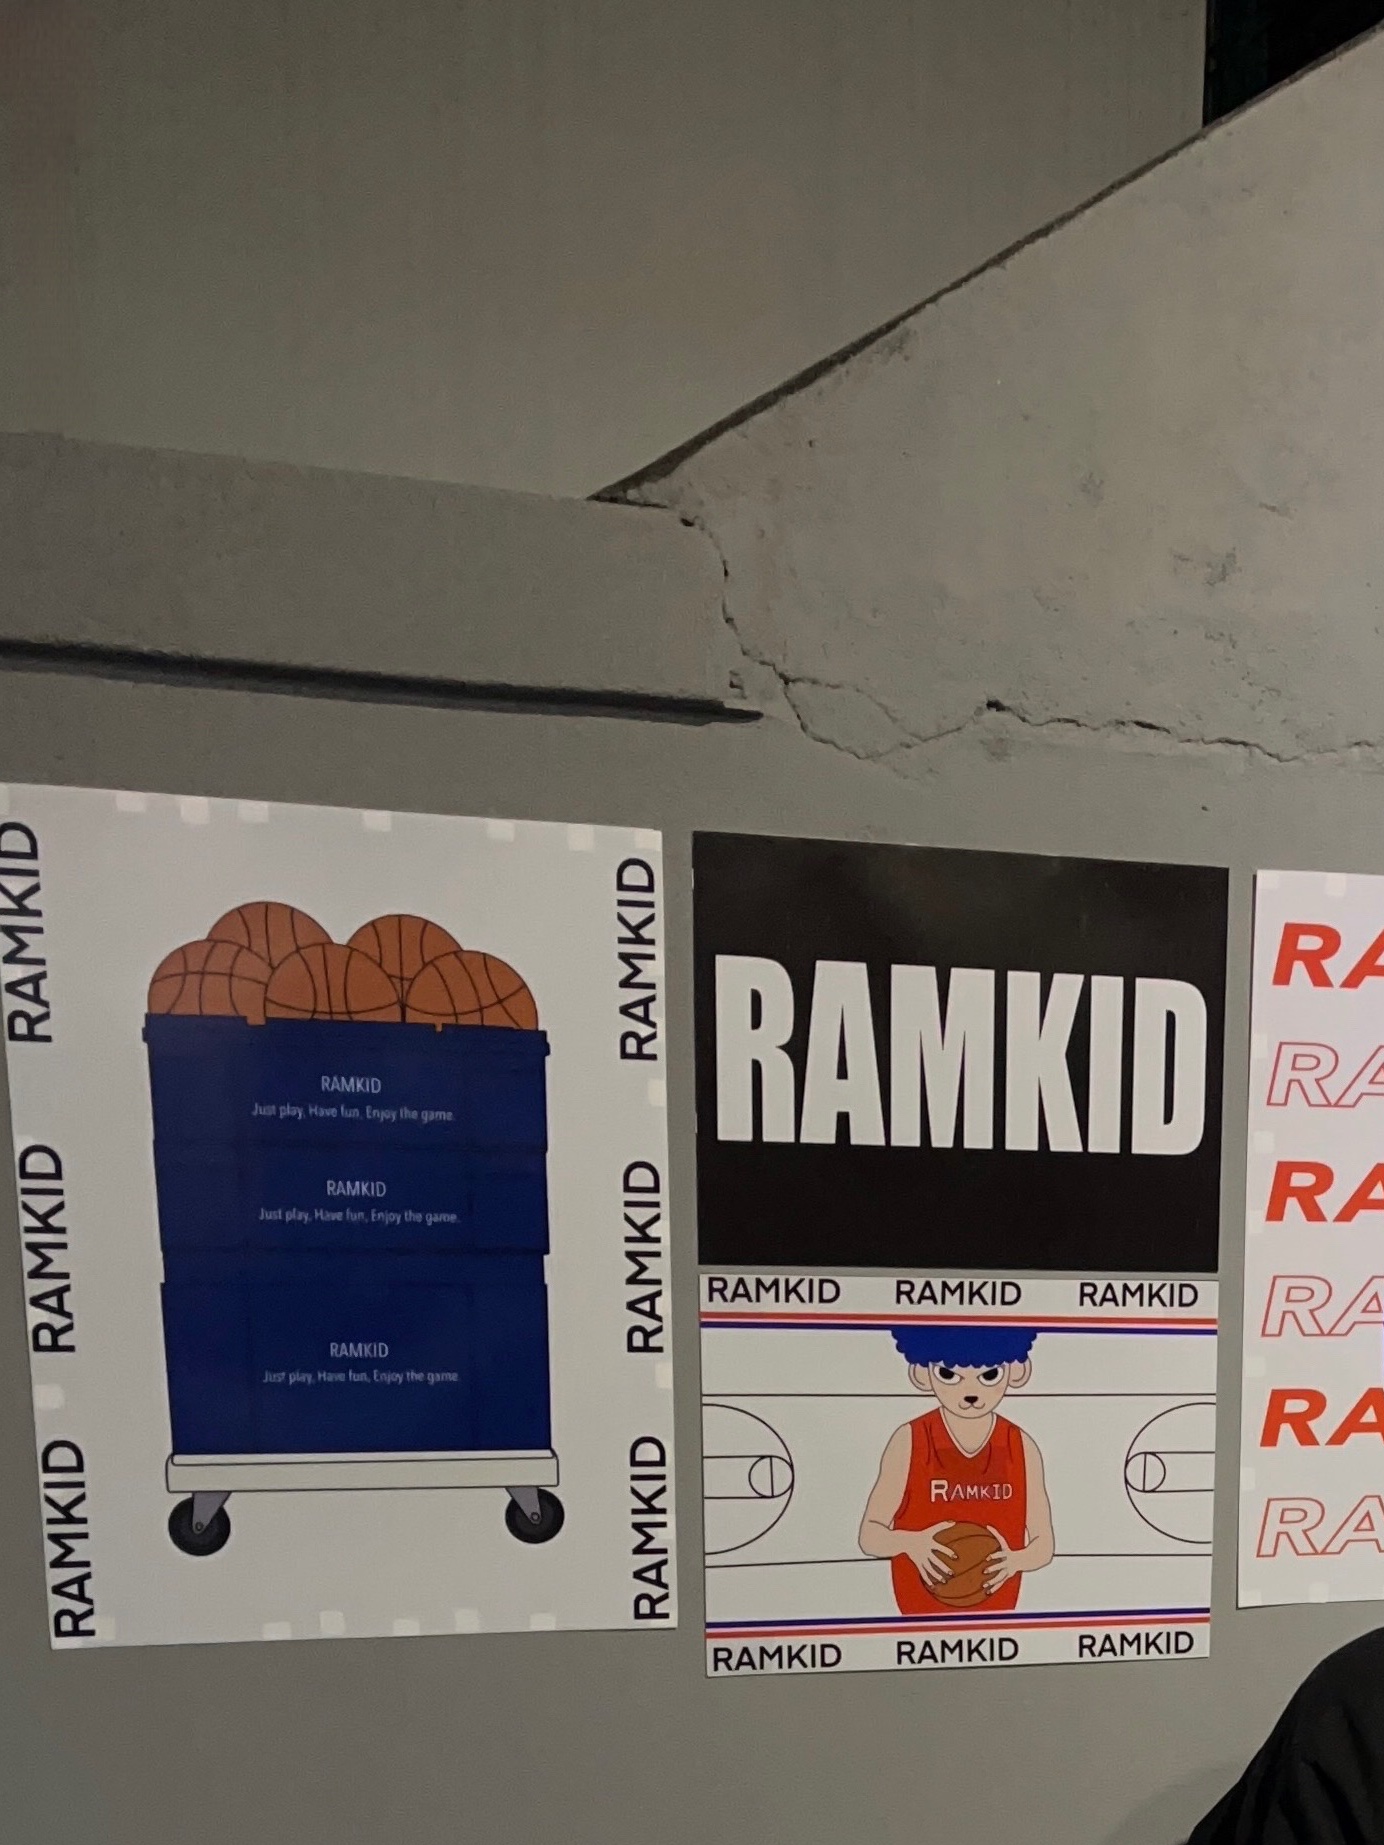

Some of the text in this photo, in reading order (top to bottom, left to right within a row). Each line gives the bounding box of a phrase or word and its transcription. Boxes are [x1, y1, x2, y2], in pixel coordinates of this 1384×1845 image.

[0, 821, 53, 1043] RAMKID
[617, 857, 659, 1061] RAMKID
[714, 954, 1208, 1157] RAMKID
[321, 1075, 381, 1094] RAMKID
[252, 1103, 276, 1116] Just
[309, 1104, 338, 1118] Have
[366, 1105, 397, 1122] Enjoy
[400, 1106, 418, 1119] the
[326, 1180, 387, 1197] RAMKID
[258, 1208, 282, 1221] Just
[314, 1209, 343, 1222] Have
[371, 1209, 401, 1226] Enjoy
[404, 1210, 423, 1223] the
[19, 1144, 76, 1353] RAMKID
[623, 1159, 664, 1354] RAMKID
[707, 1277, 1200, 1309] RAMKID RAMKID RAMKID
[330, 1342, 389, 1358] RAMKID
[262, 1370, 286, 1383] Just
[317, 1371, 346, 1382] Have
[373, 1369, 403, 1385] Enjoy
[406, 1369, 424, 1382] the
[42, 1438, 97, 1639] RAMKID
[629, 1435, 671, 1623] RAMKID
[713, 1631, 1195, 1673] RAMKID RAMKID RAMKID
